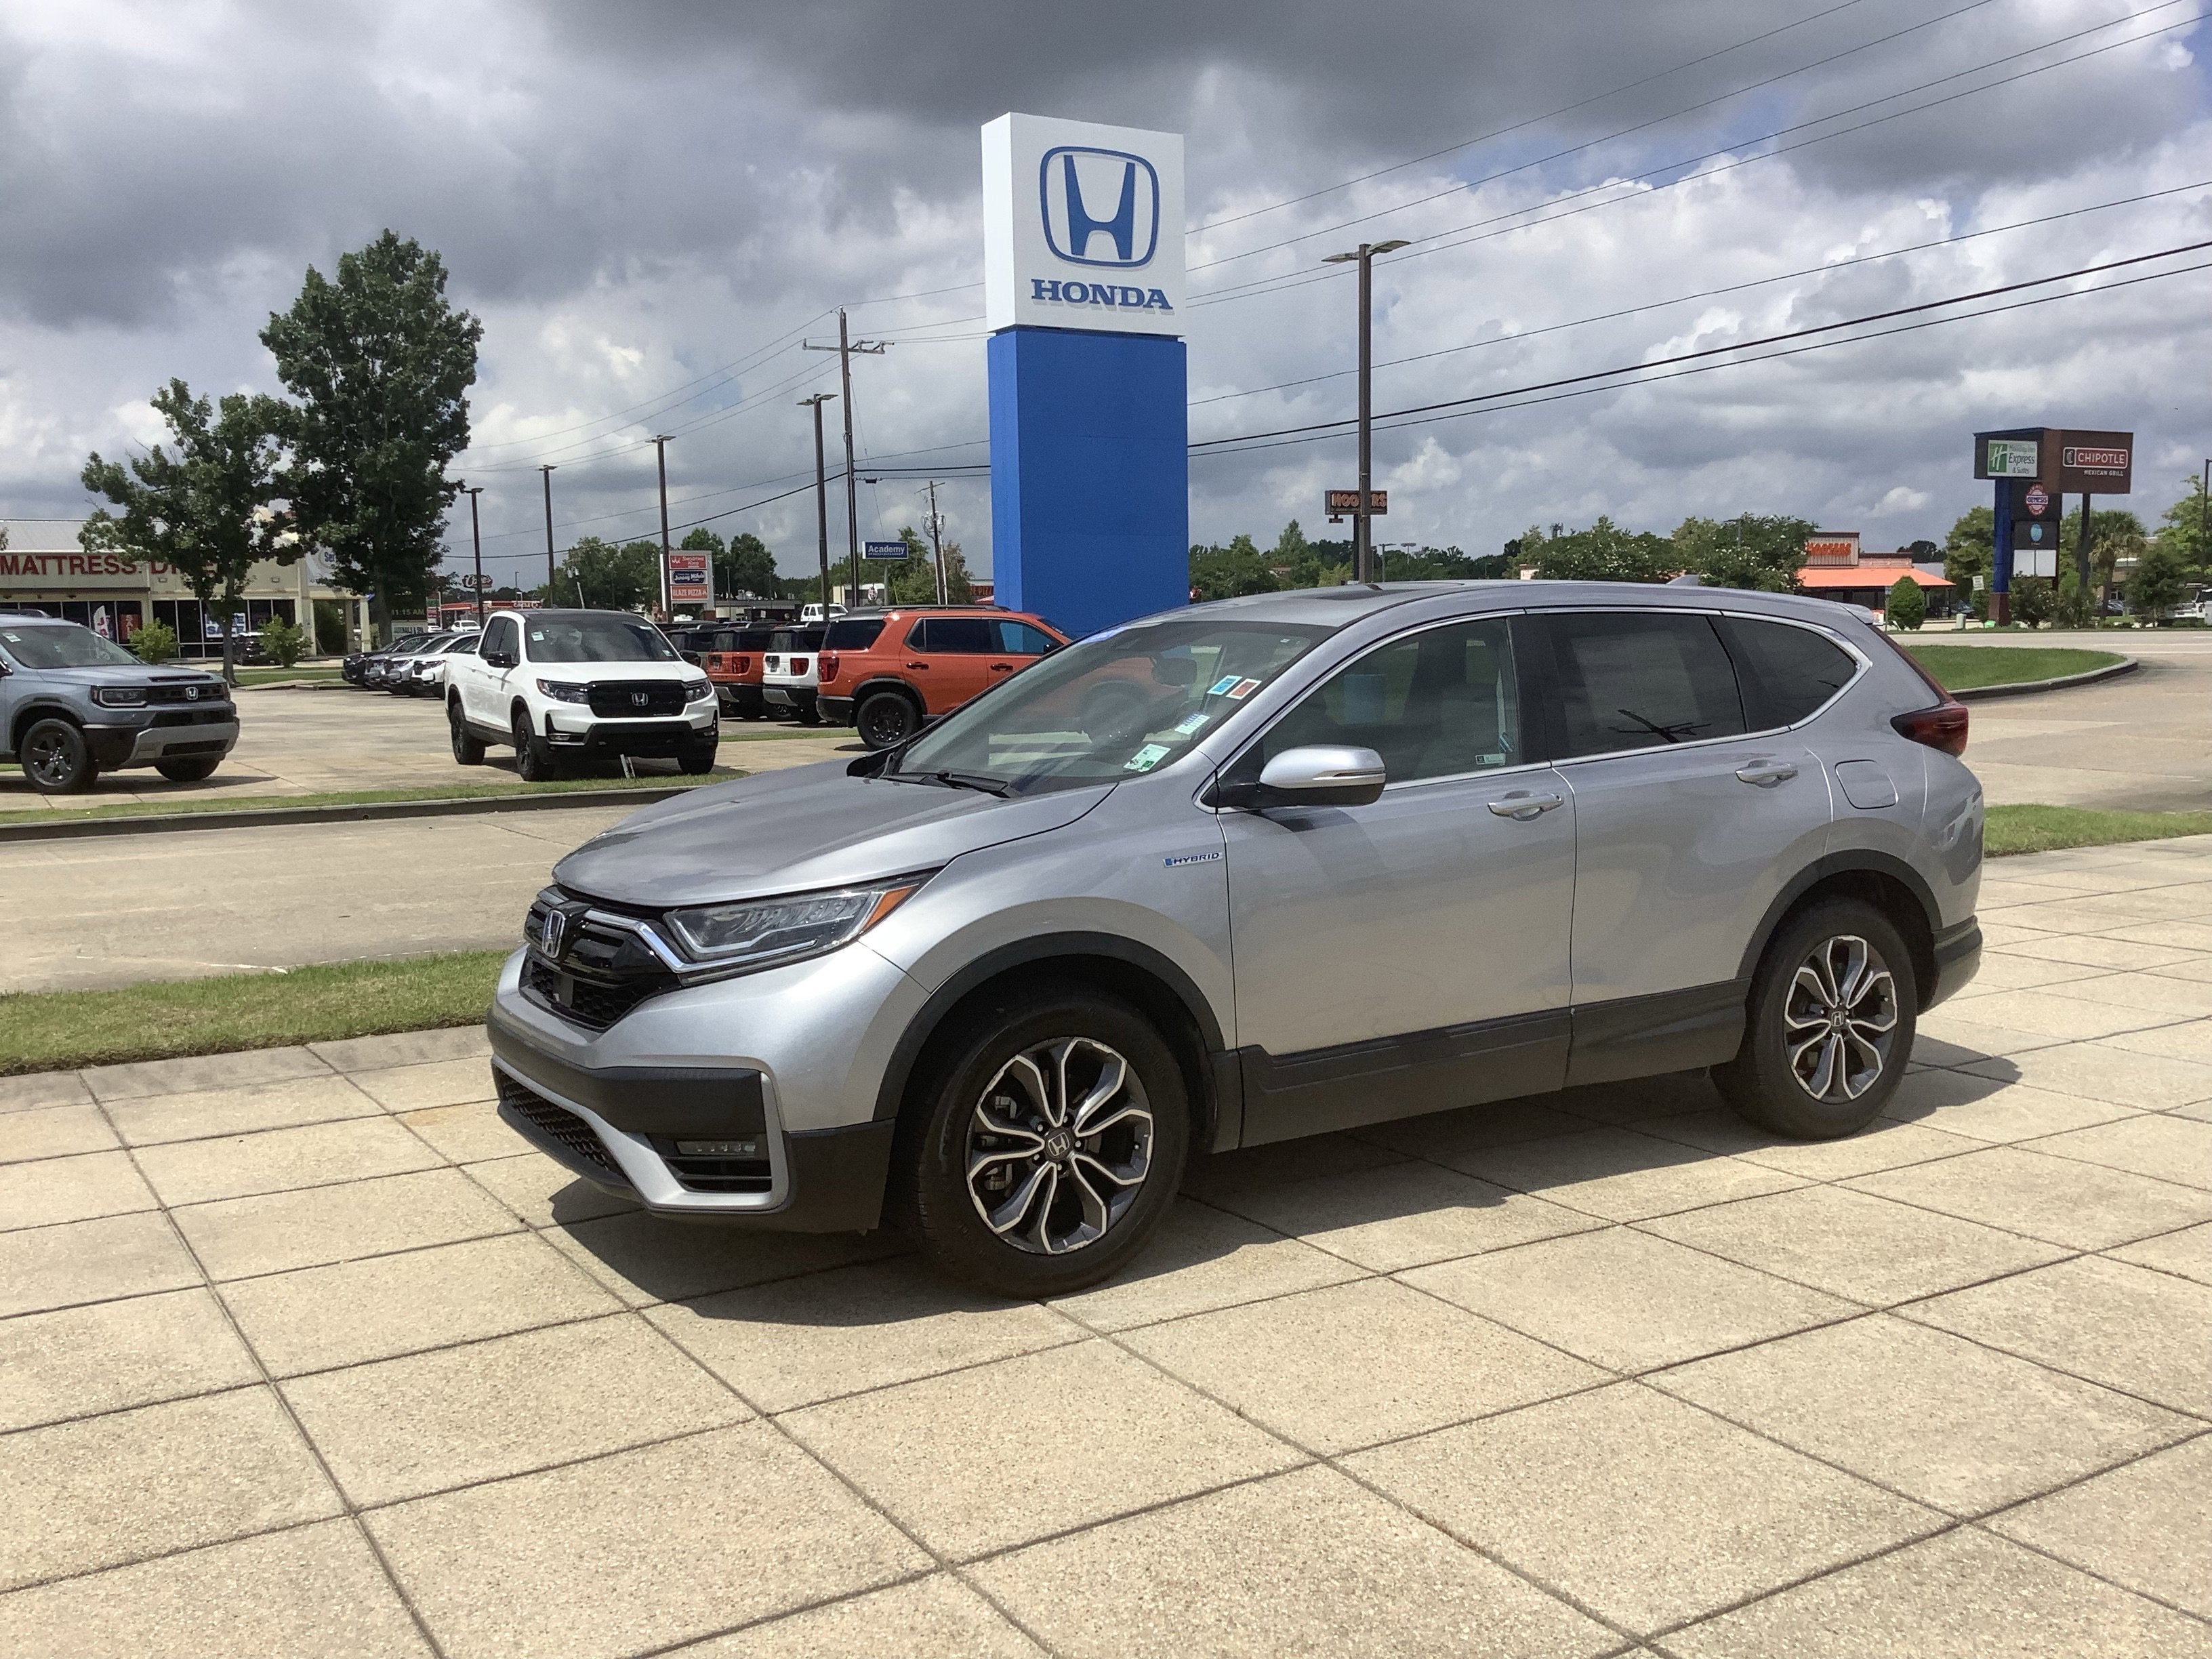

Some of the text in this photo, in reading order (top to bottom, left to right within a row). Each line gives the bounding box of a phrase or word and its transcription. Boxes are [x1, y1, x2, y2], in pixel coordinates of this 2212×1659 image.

[1031, 279, 1173, 310] HONDA
[2009, 453, 2035, 465] Express
[2078, 453, 2125, 464] CHIPOTLE
[1332, 493, 1387, 507] HOORS
[868, 545, 905, 555] Academy
[1, 554, 137, 575] MATTRESS
[1174, 853, 1220, 864] HYBRID
